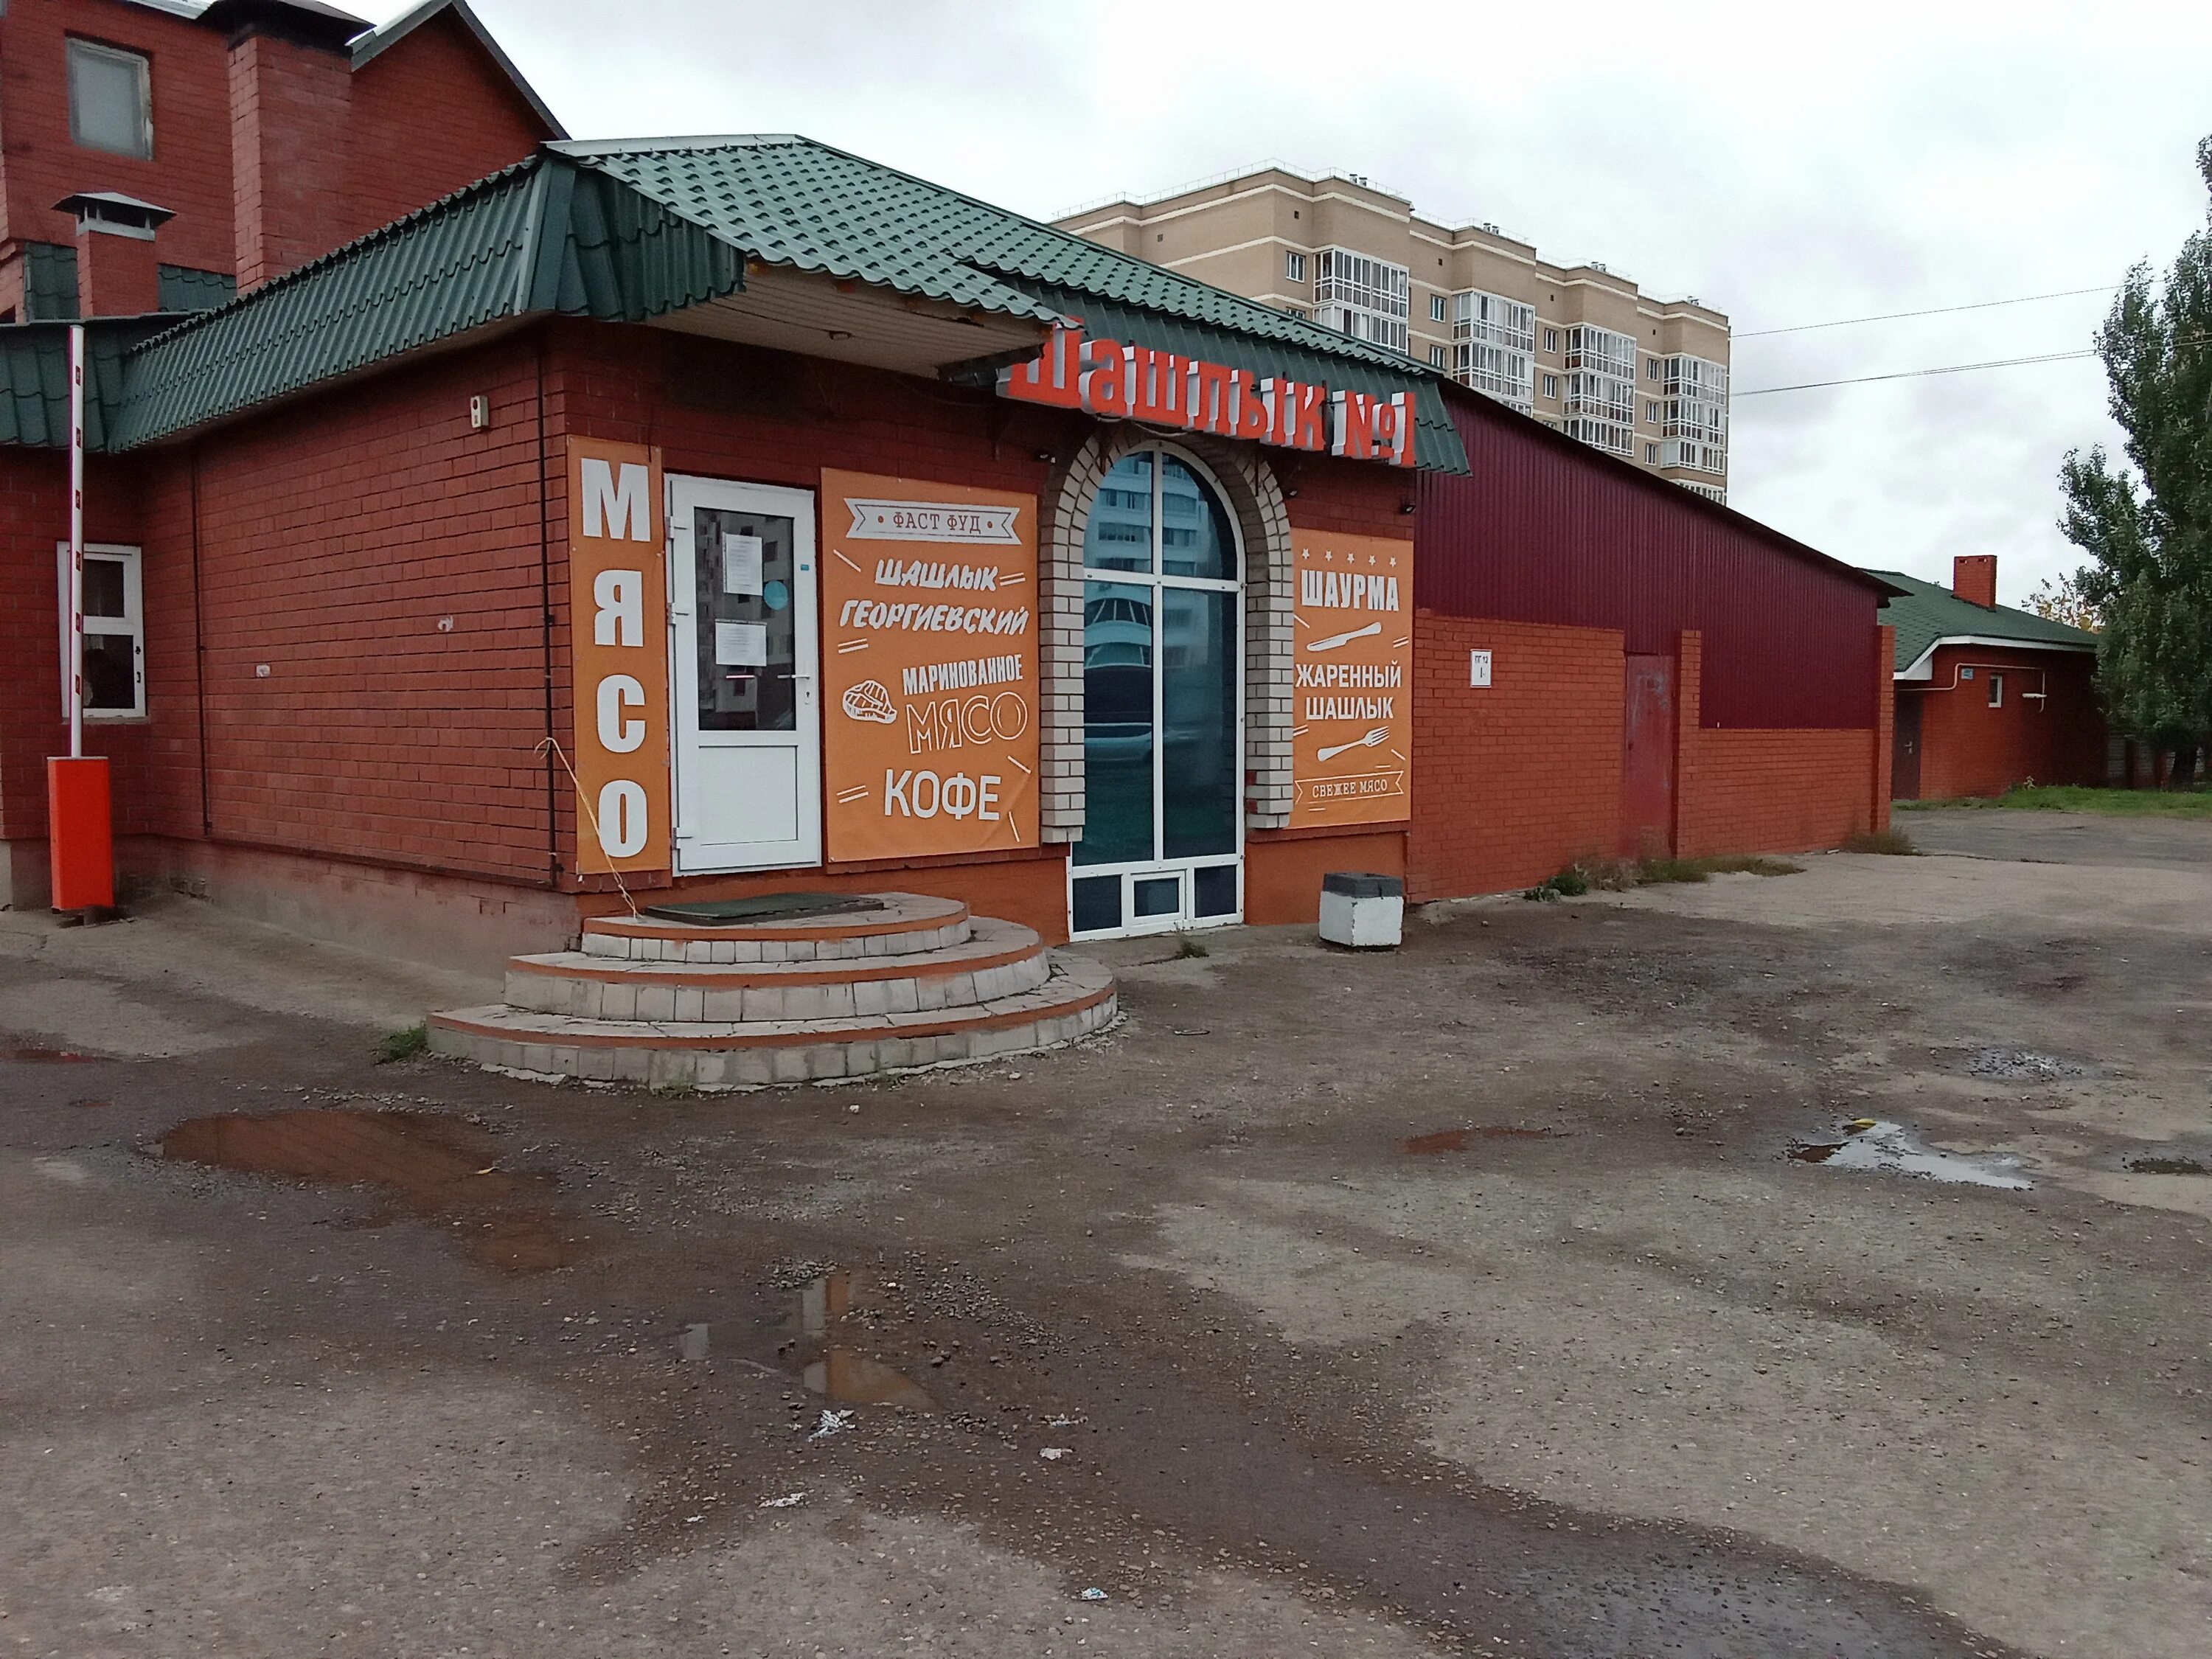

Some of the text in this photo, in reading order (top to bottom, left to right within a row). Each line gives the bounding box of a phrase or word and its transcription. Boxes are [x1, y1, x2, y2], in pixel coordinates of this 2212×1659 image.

[995, 315, 1416, 468] Шашлык №1
[892, 512, 981, 534] ФАСТ ФУД
[874, 559, 998, 591] ШАШЛЫК
[1301, 569, 1400, 611] ШАУРМА
[839, 599, 1029, 636] ГЕОРГИЕВСКИЙ
[581, 458, 651, 858] МЯСО
[902, 653, 1023, 696] МАРИНОВАННОЕ
[1295, 660, 1402, 689] ЖАРЕННЫЙ
[905, 691, 1028, 754] МЯСО
[1305, 696, 1394, 720] ШАШЛЫК
[884, 769, 1001, 821] КОФЕ
[1311, 779, 1388, 799] СВЕЖЕЕ МЯСО
